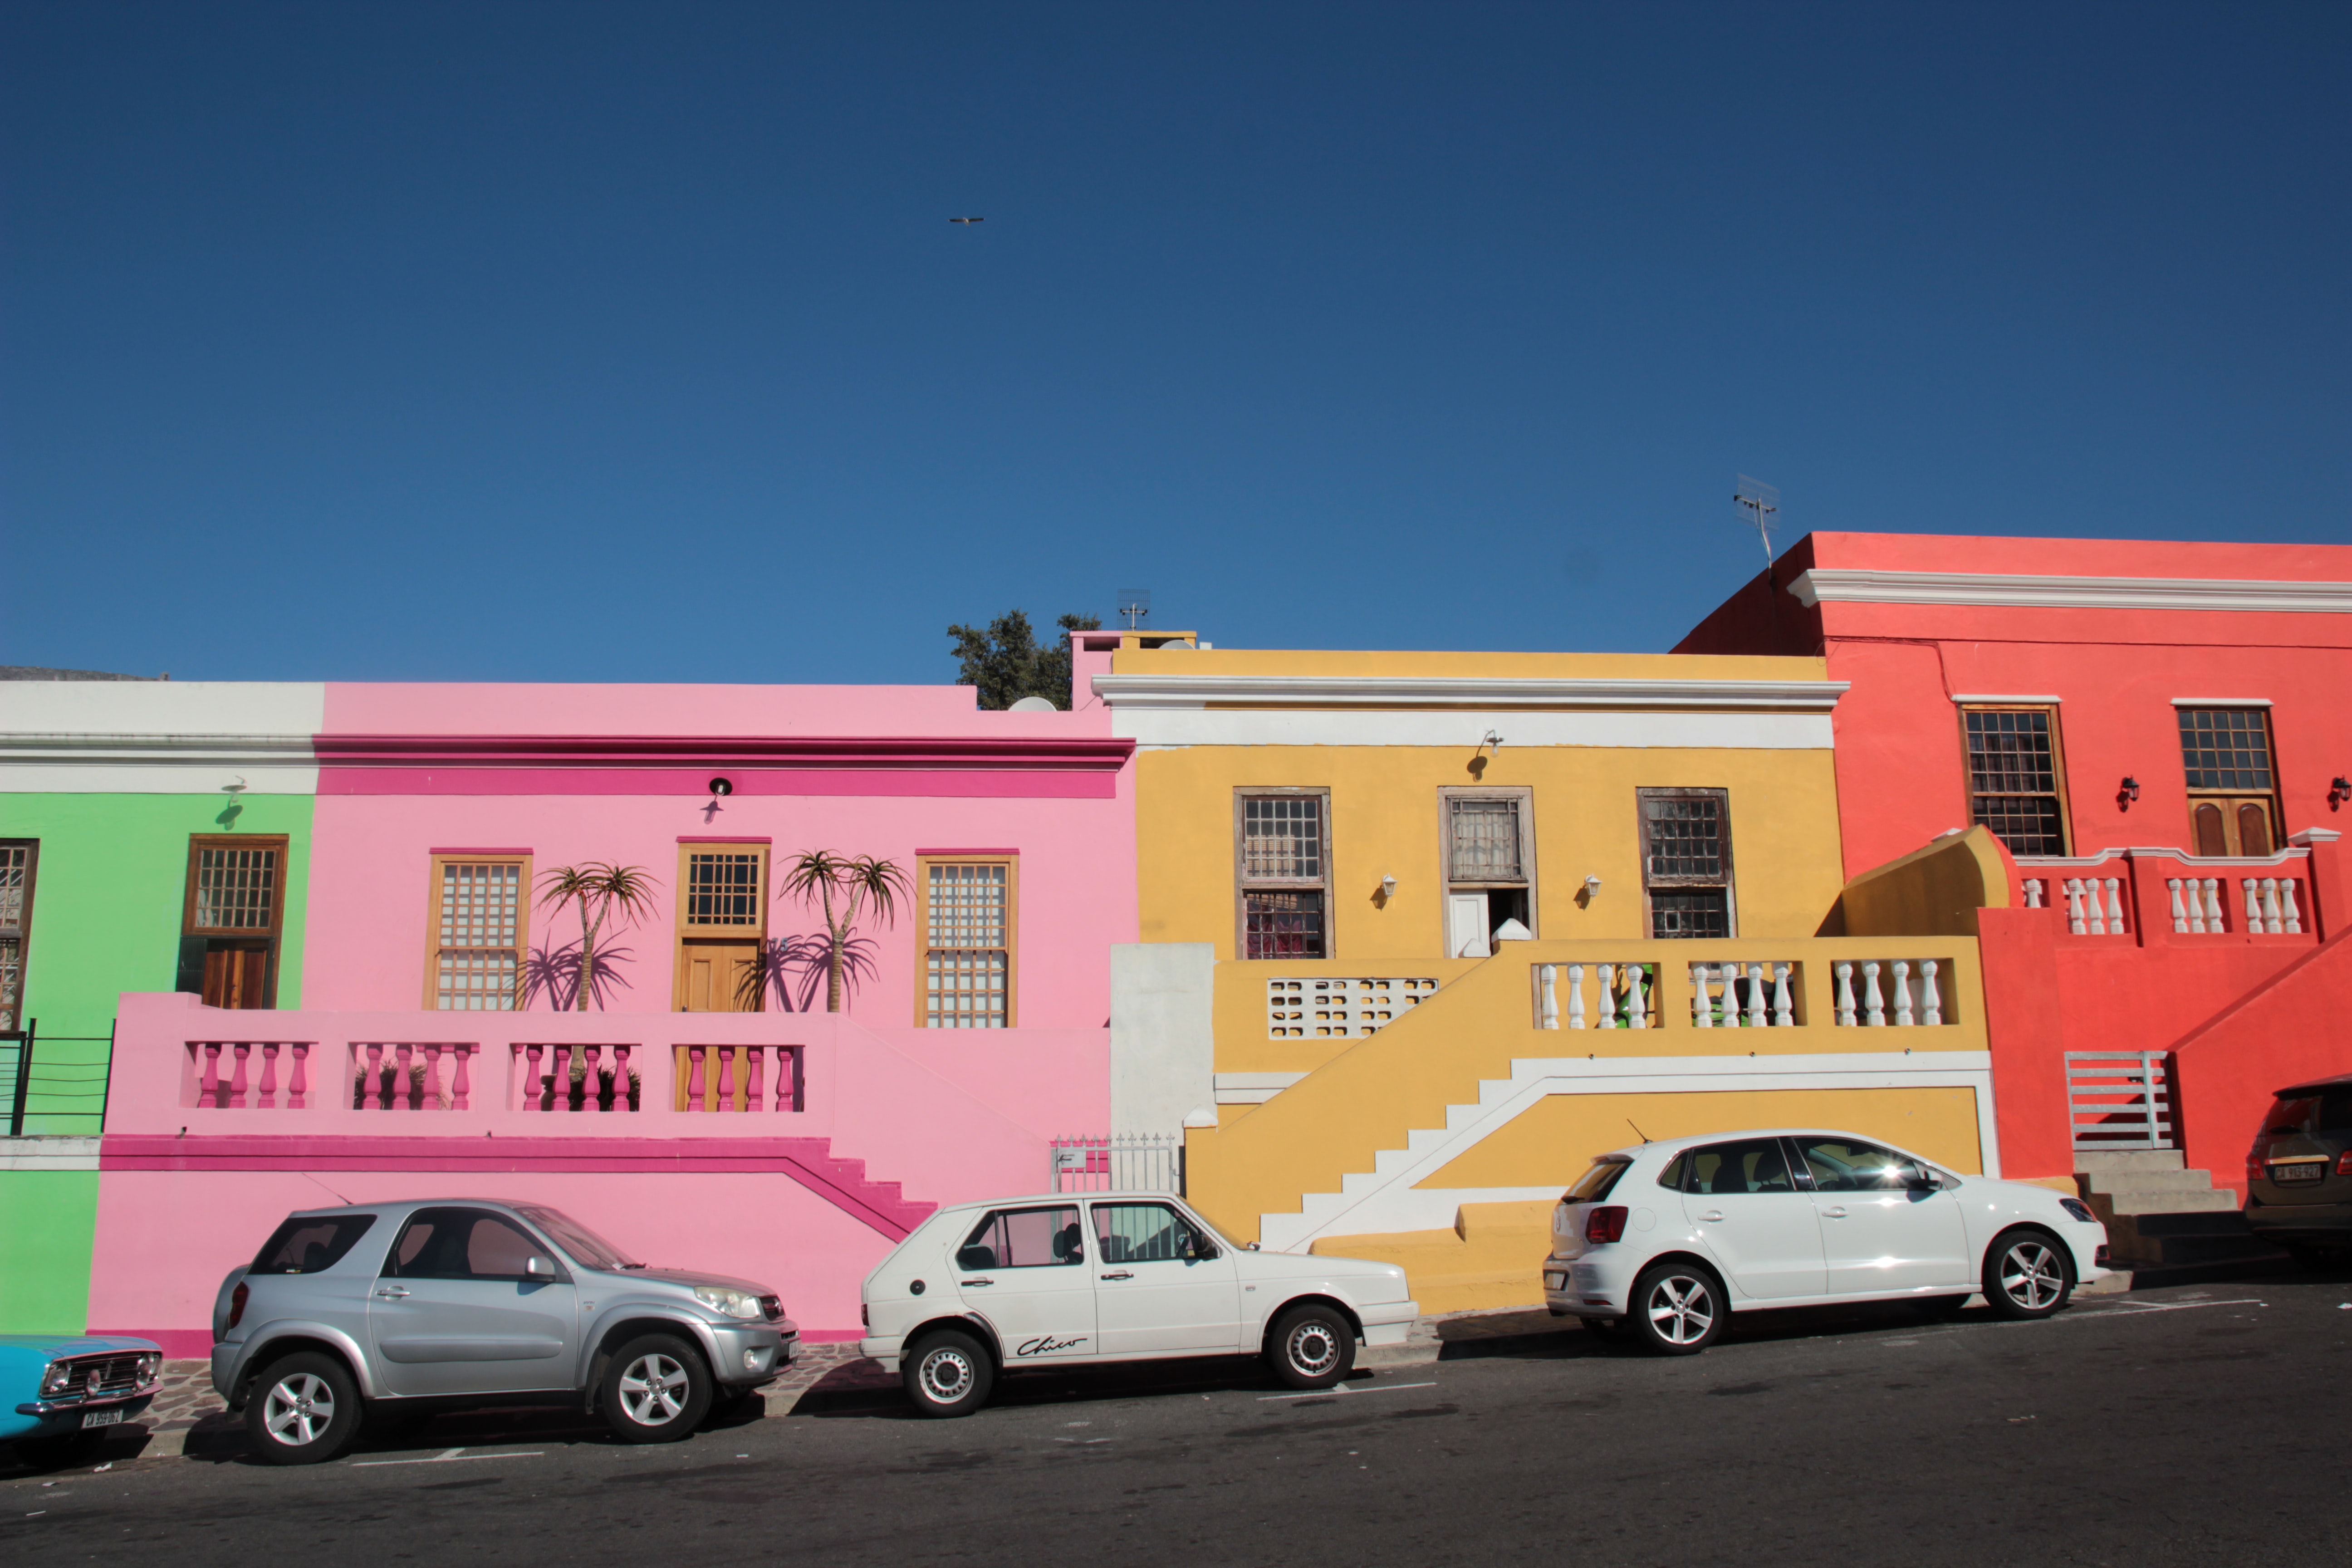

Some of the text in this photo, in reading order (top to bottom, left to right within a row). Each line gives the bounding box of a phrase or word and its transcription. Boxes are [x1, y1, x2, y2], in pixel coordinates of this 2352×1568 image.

[772, 937, 788, 952] 75
[2276, 1168, 2285, 1179] CA
[1017, 1336, 1088, 1356] Chico
[86, 1413, 95, 1427] CA
